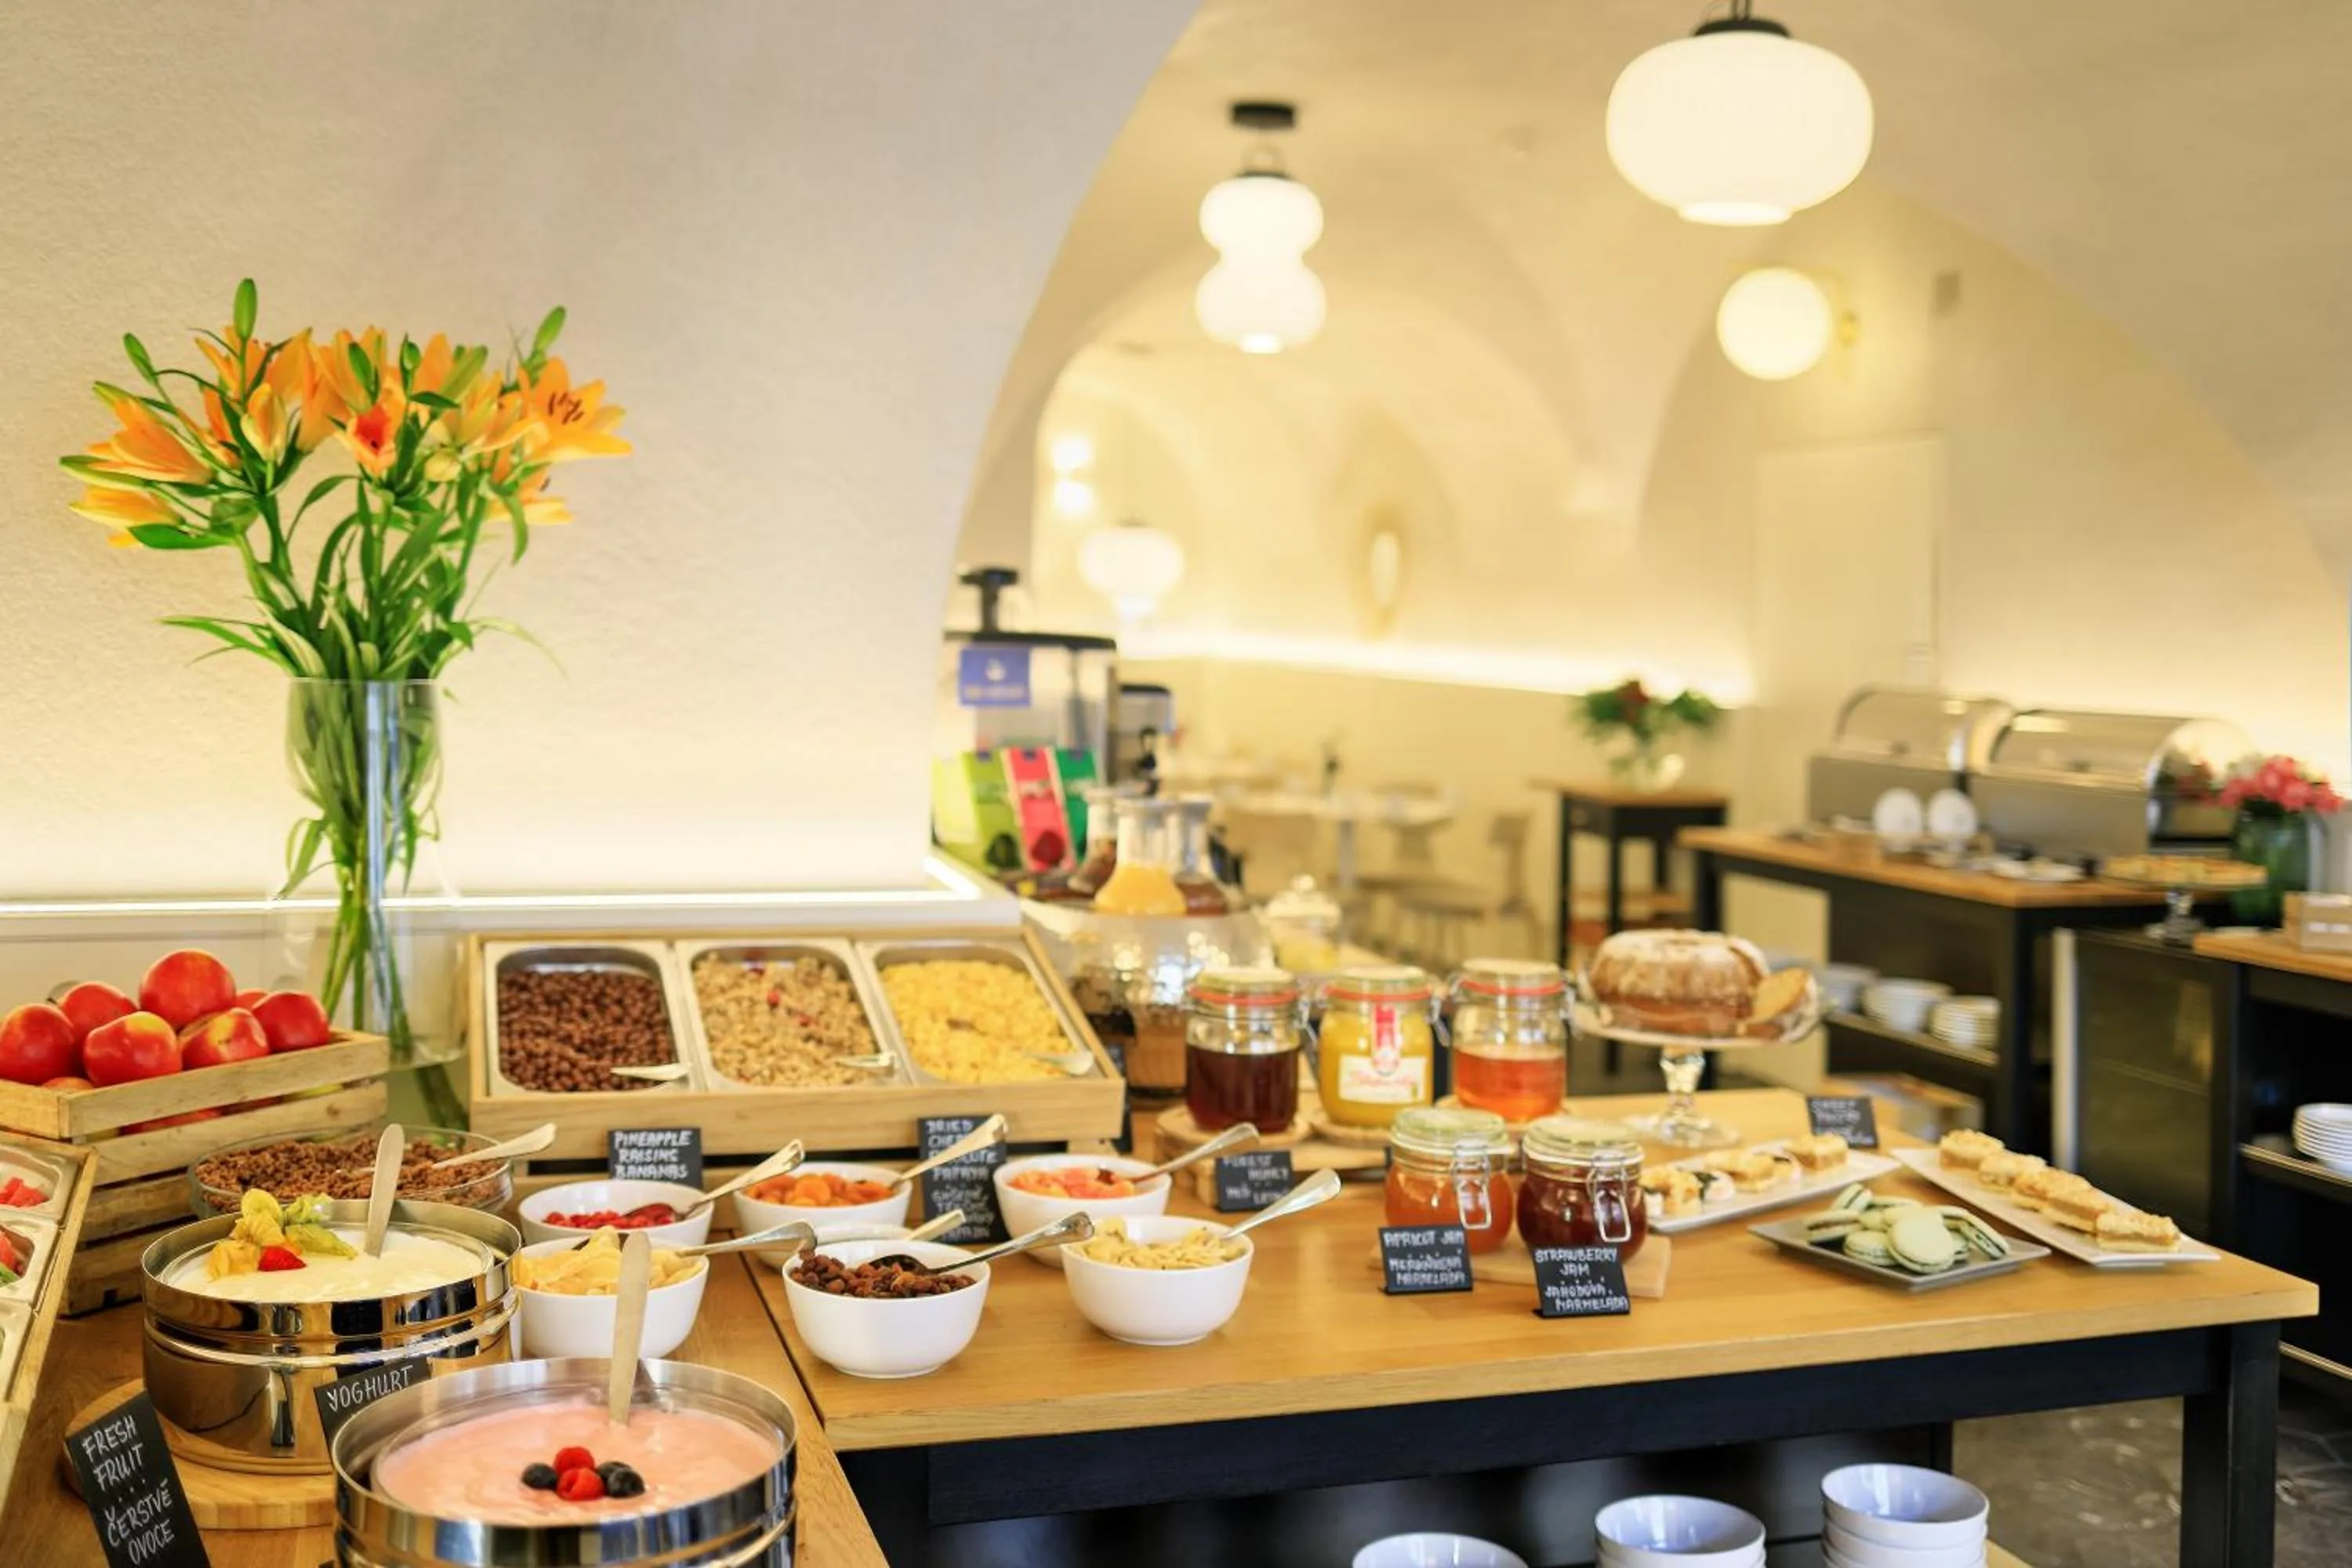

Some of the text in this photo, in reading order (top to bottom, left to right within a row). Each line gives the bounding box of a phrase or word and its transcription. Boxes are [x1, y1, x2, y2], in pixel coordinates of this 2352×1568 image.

[926, 1120, 974, 1134] DRIED
[615, 1131, 692, 1149] PINEAPPLE
[615, 1164, 688, 1180] BANANAS
[1383, 1229, 1465, 1248] APRICOT JAM
[1535, 1247, 1617, 1263] STRAWBERRY
[1559, 1262, 1590, 1276] JAM
[328, 1365, 414, 1411] YOGHURT
[82, 1414, 138, 1460] FRESH
[93, 1443, 145, 1492] FRUIT
[104, 1479, 174, 1548] ČERSTVÉ
[129, 1519, 175, 1566] OVOCE
